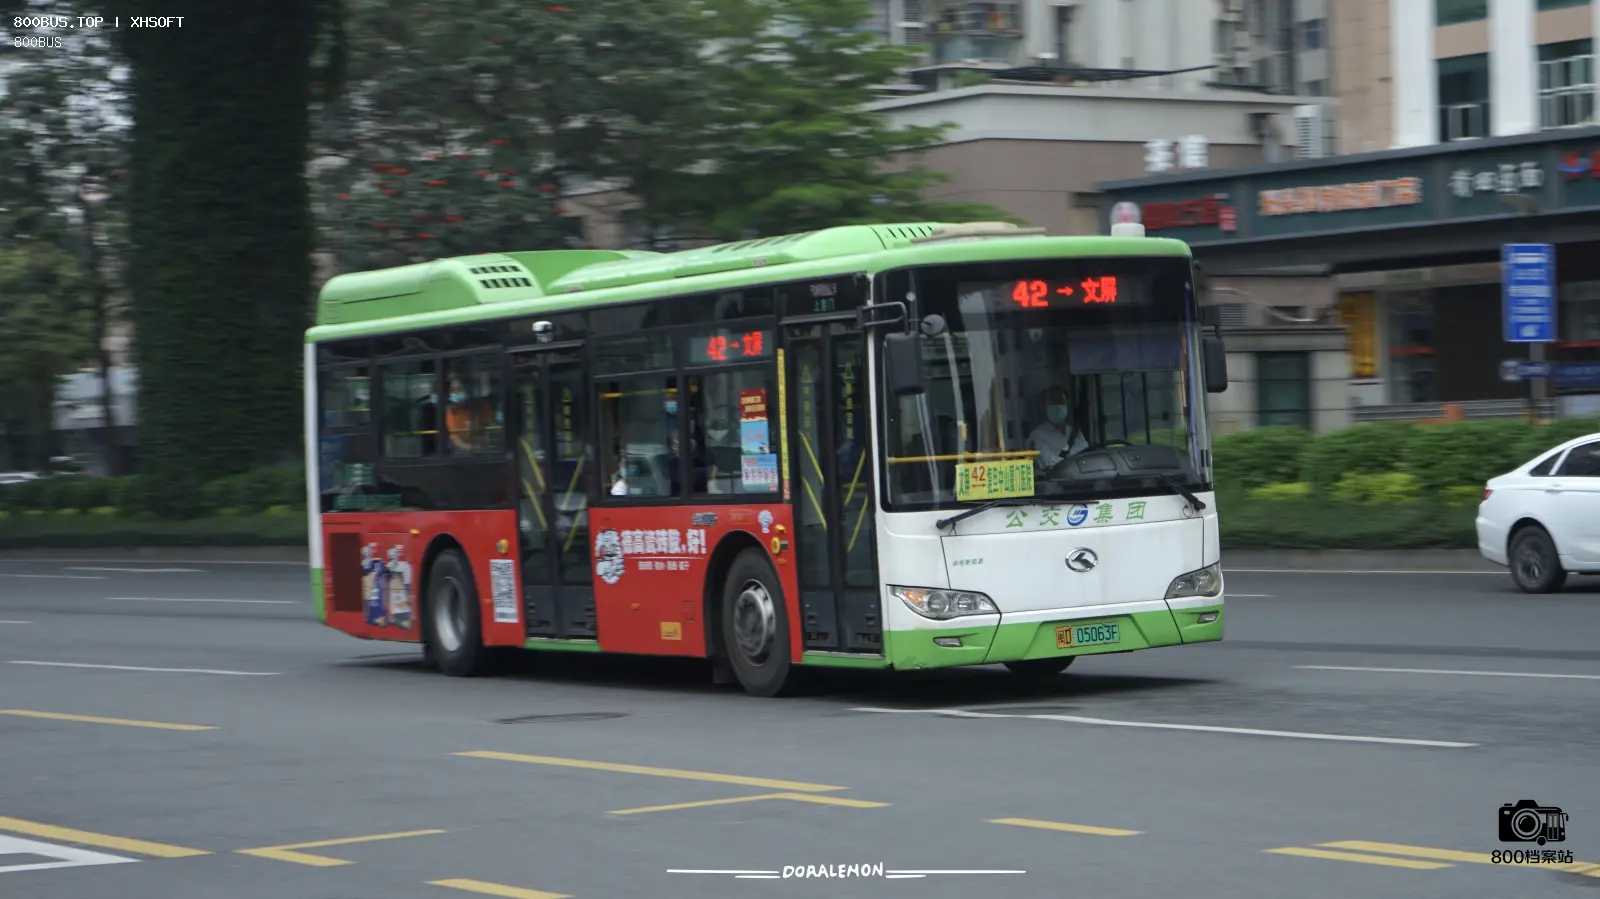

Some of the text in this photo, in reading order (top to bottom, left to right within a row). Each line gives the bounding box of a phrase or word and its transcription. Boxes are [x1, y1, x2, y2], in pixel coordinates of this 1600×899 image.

[1012, 276, 1117, 308] 42 文屏
[707, 335, 728, 361] 42
[972, 465, 987, 482] 42
[1006, 501, 1148, 529] 公交集团
